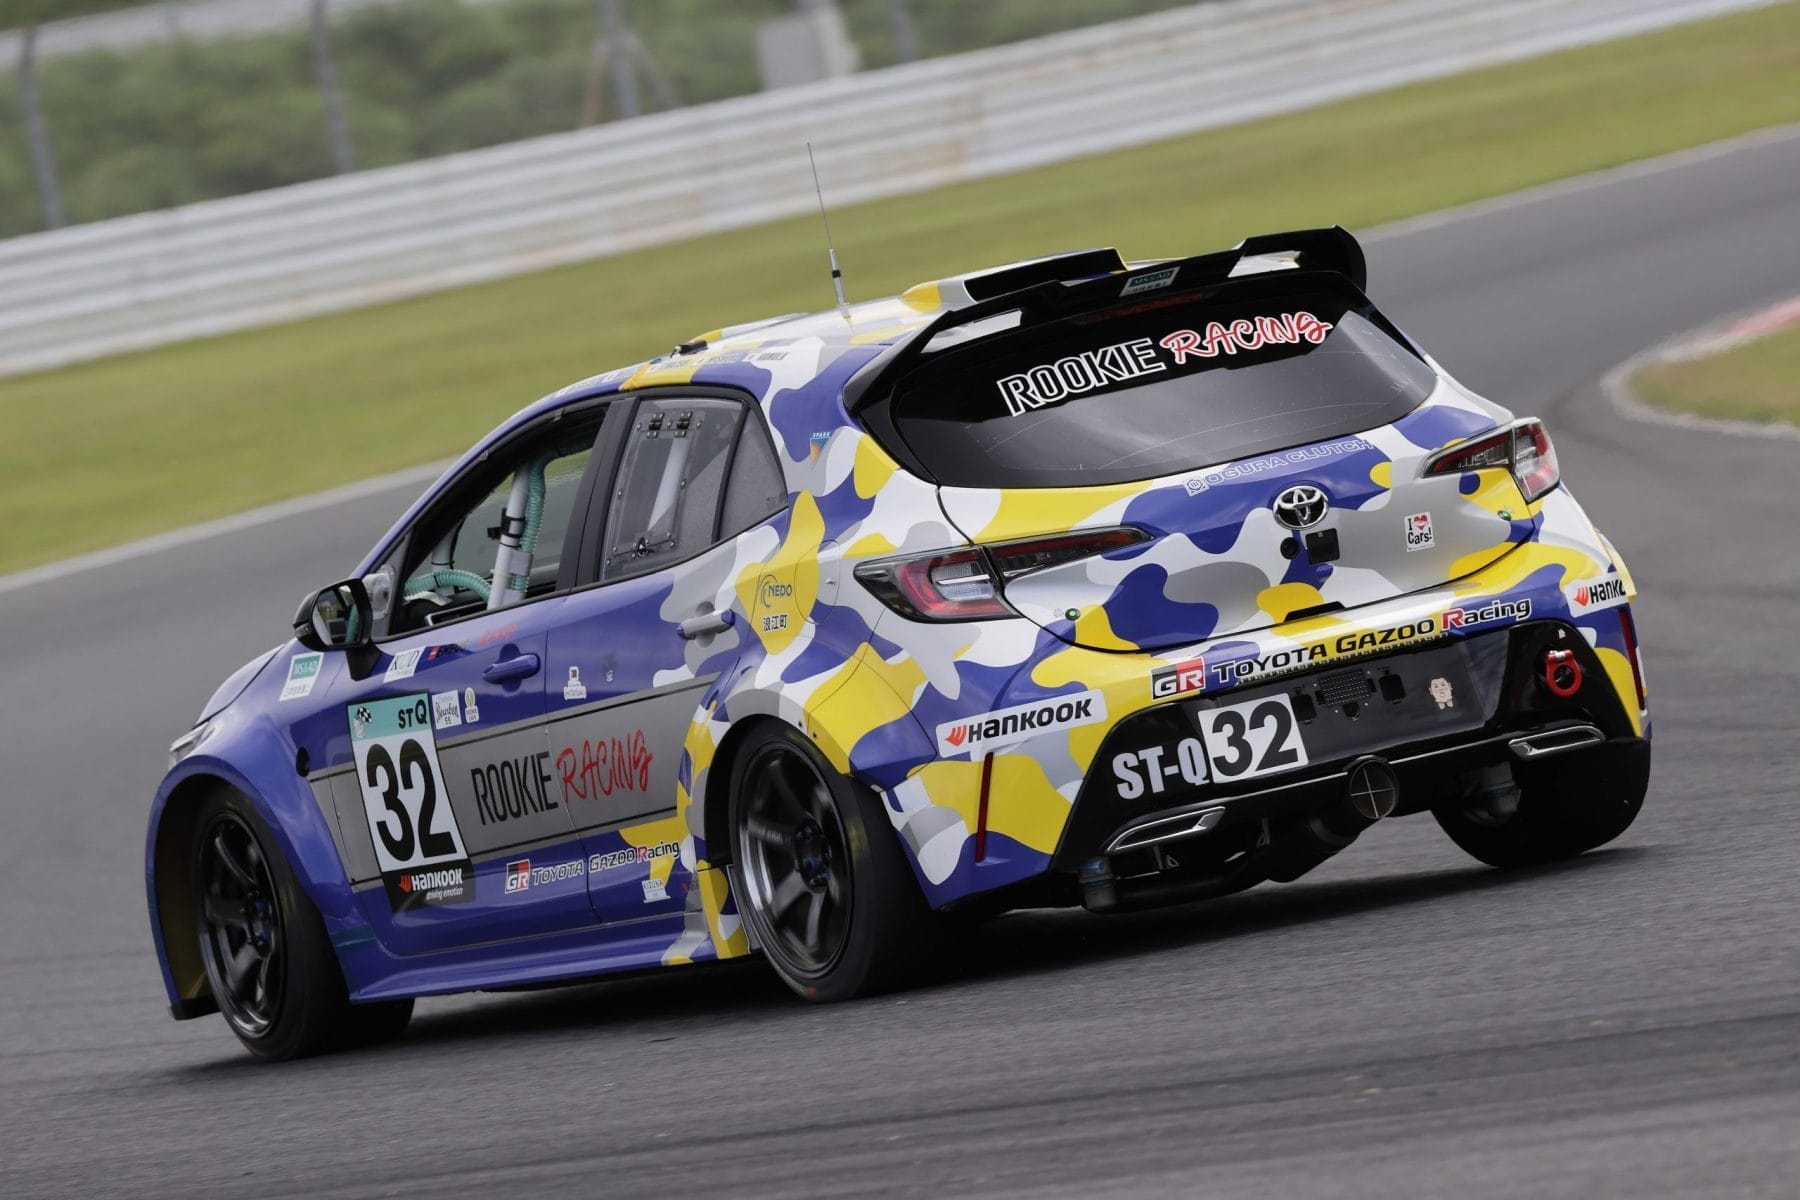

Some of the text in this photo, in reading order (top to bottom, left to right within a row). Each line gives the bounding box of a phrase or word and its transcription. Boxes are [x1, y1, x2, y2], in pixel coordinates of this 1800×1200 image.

[997, 311, 1332, 417] ROOKIE RACING
[1204, 438, 1376, 486] OGURA CLUTCH
[1407, 518, 1413, 531] I
[1407, 526, 1433, 545] Cars!
[768, 584, 793, 597] NEDO
[1153, 598, 1532, 698] GR TOYOTA GAZOO Racing
[1113, 737, 1209, 800] ST-Q
[1211, 700, 1300, 779] 32
[366, 739, 458, 862] 32
[470, 728, 653, 825] ROOKIE RACING
[506, 840, 680, 893] GR TOYOTA GAZOO Racing
